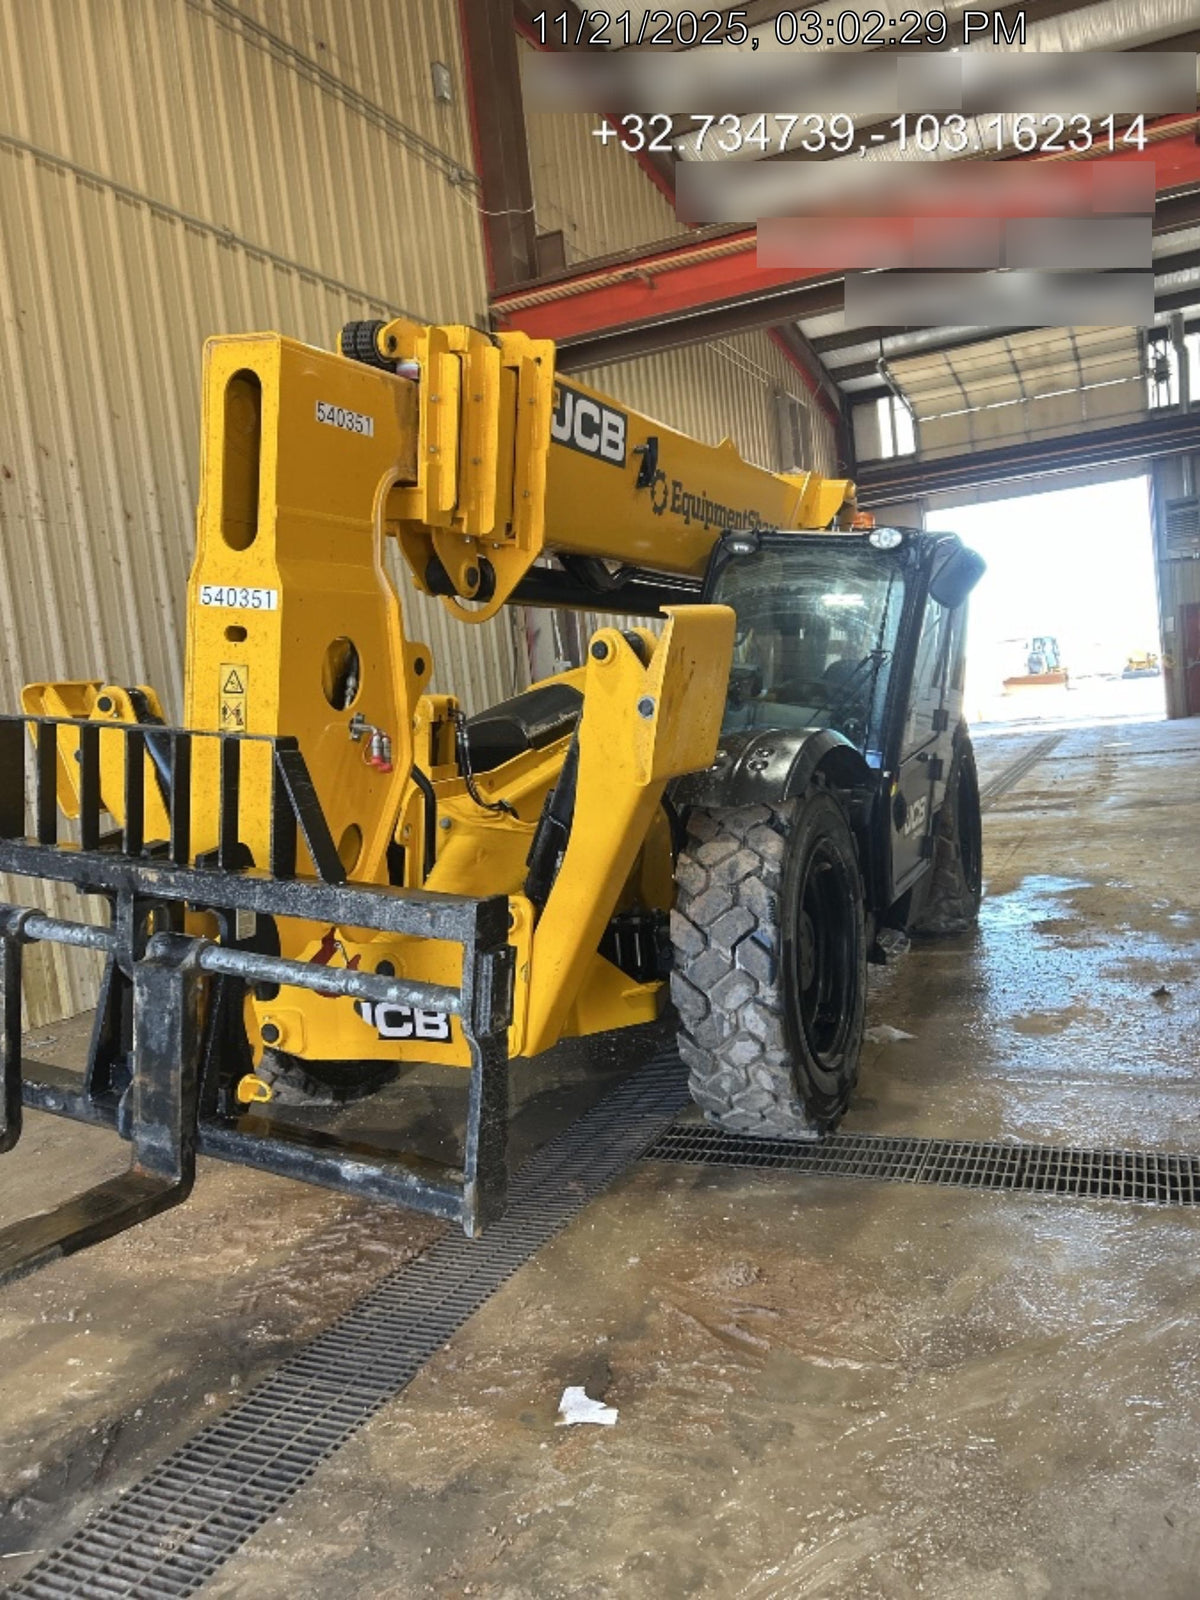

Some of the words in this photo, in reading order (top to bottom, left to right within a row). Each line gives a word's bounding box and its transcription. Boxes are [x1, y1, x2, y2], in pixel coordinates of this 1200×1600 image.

[317, 402, 371, 437] 540351
[551, 391, 625, 462] JCB
[201, 585, 272, 609] 540351
